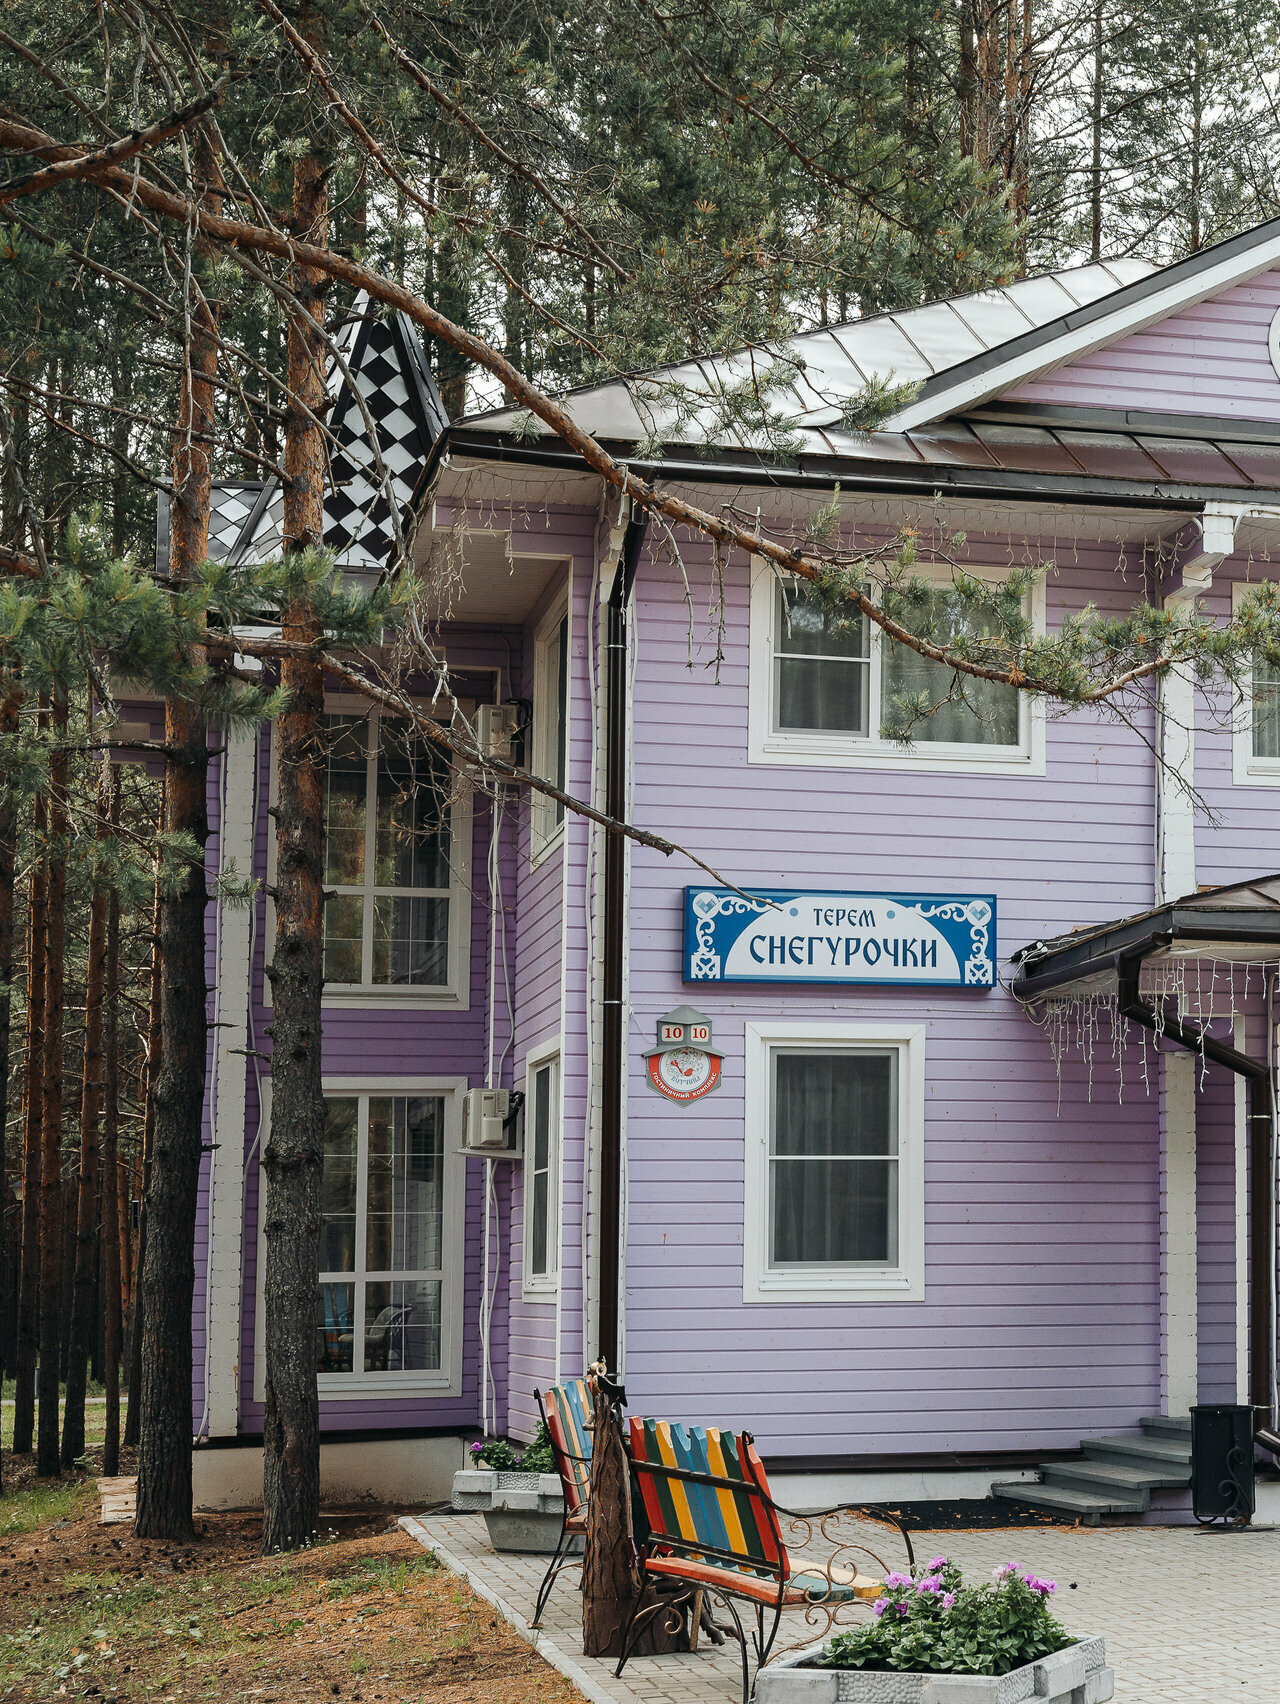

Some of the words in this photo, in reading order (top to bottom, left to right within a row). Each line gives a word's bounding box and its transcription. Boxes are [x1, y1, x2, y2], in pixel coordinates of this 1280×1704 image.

[812, 908, 877, 928] ТЕРЕМ
[749, 935, 938, 968] СНЕГУРОЧКИ
[665, 1027, 682, 1039] 10
[692, 1027, 707, 1039] 10
[652, 1072, 690, 1098] ГОСТИНИЧНЫЙ
[692, 1072, 717, 1097] КОМПЛЕКС
